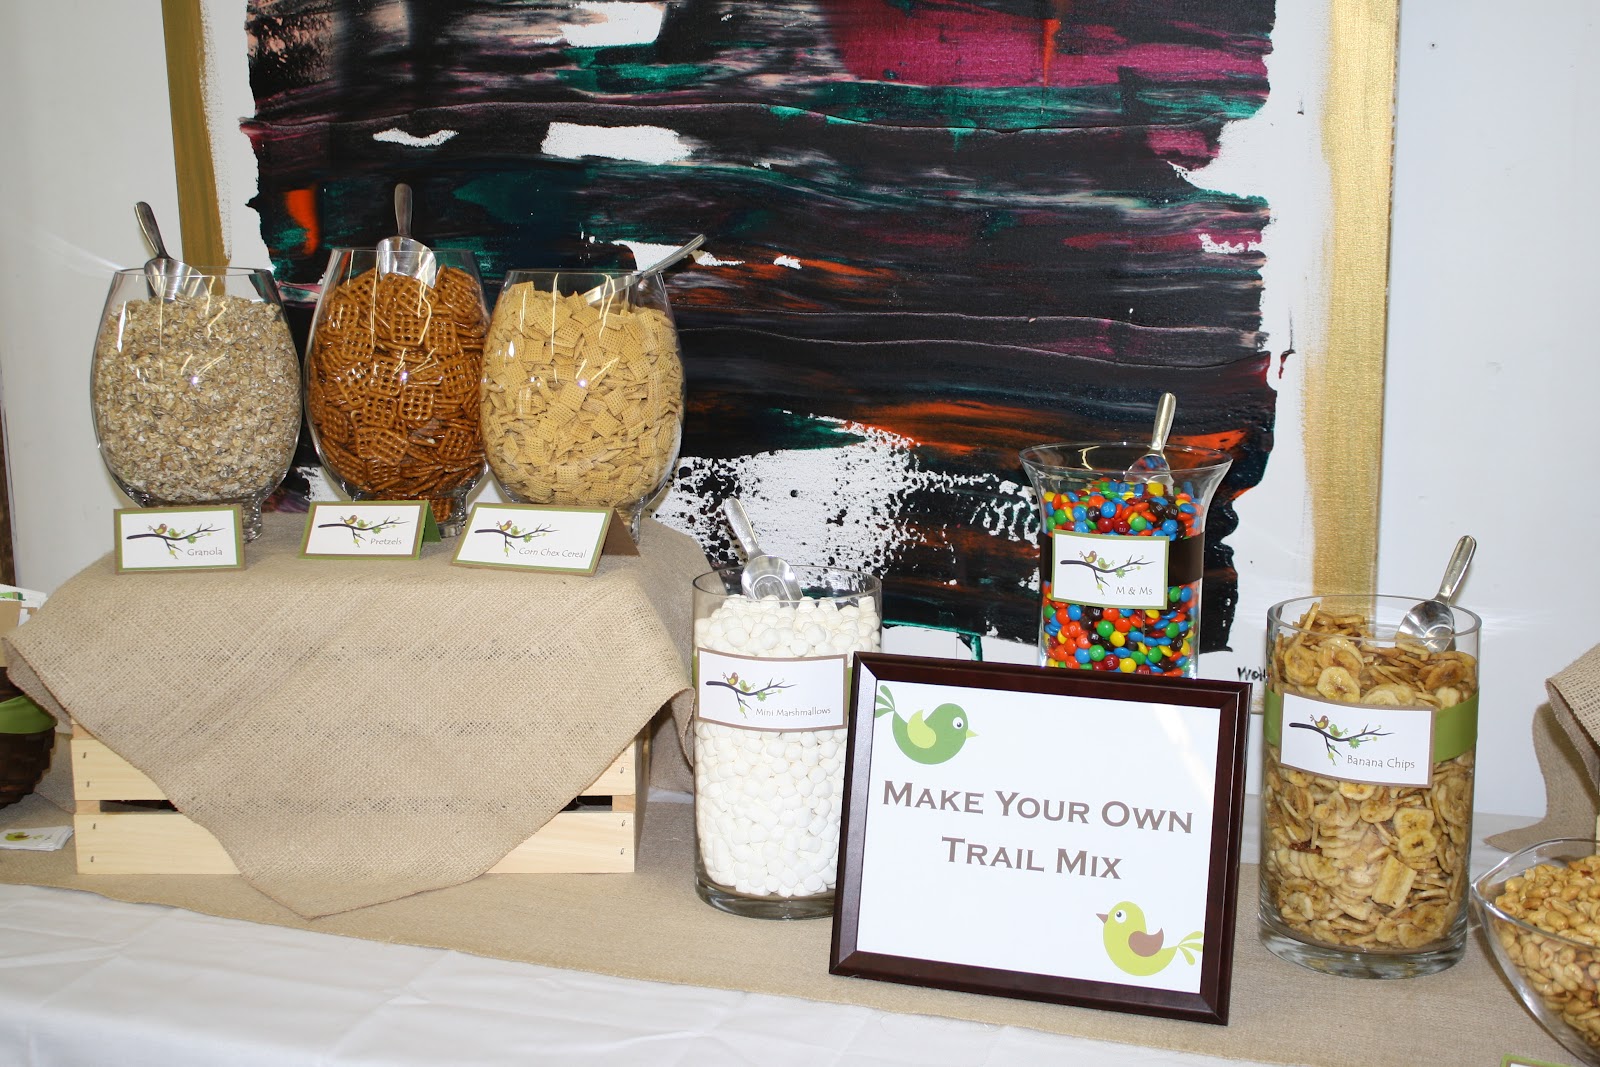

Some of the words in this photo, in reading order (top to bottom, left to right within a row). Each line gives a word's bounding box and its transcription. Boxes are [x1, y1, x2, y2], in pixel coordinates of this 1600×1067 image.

[370, 537, 402, 545] Pretzels
[187, 546, 223, 556] Granola
[518, 547, 539, 556] Corn
[540, 547, 560, 557] Chex
[561, 549, 587, 559] Cereal
[1115, 586, 1125, 595] M
[1127, 586, 1136, 595] &
[1139, 586, 1153, 596] Ms
[755, 707, 774, 717] Mini
[776, 706, 831, 717] Marshmallows
[1347, 755, 1383, 769] Banana
[1386, 757, 1416, 772] Chips
[882, 780, 984, 815] MAKE
[995, 790, 1090, 824] YOUR
[1101, 800, 1193, 834] OWN
[941, 835, 1045, 873] TRAIL
[1055, 848, 1122, 880] MIX
